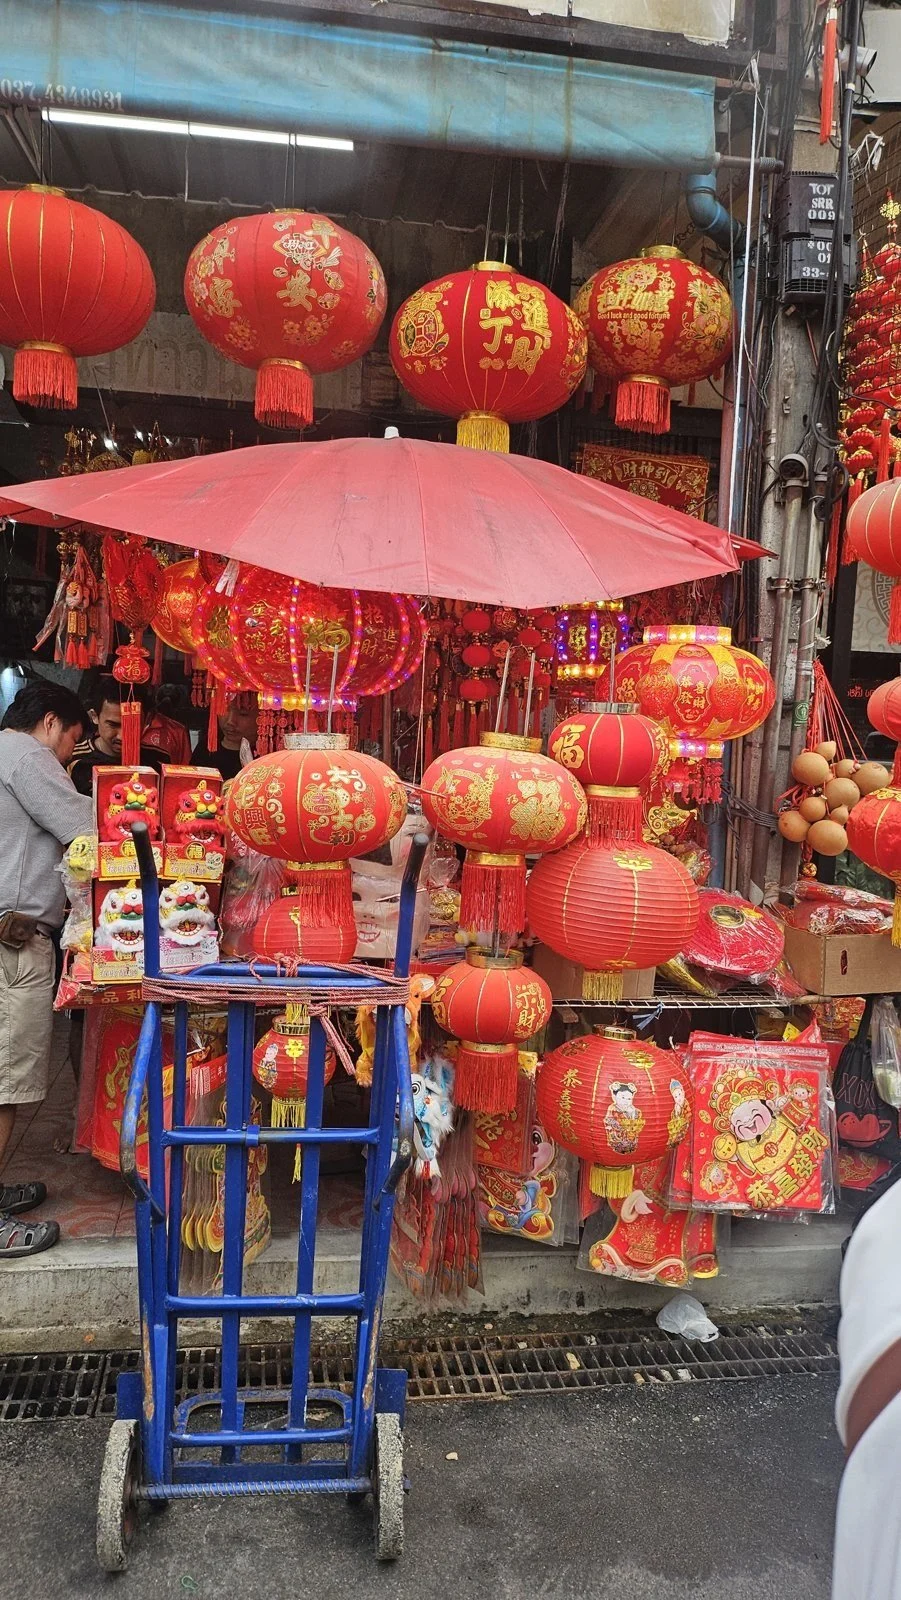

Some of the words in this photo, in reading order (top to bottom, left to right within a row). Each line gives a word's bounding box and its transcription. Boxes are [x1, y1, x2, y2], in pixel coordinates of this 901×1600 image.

[808, 183, 834, 195] TOT
[811, 197, 834, 210] SRR
[807, 209, 836, 220] 009
[597, 312, 610, 320] Good
[633, 313, 648, 321] good
[622, 461, 671, 484] 財神到
[552, 723, 587, 769] 福
[188, 844, 204, 859] 福
[836, 1072, 882, 1110] XOX
[746, 1125, 829, 1208] 恭喜發財
